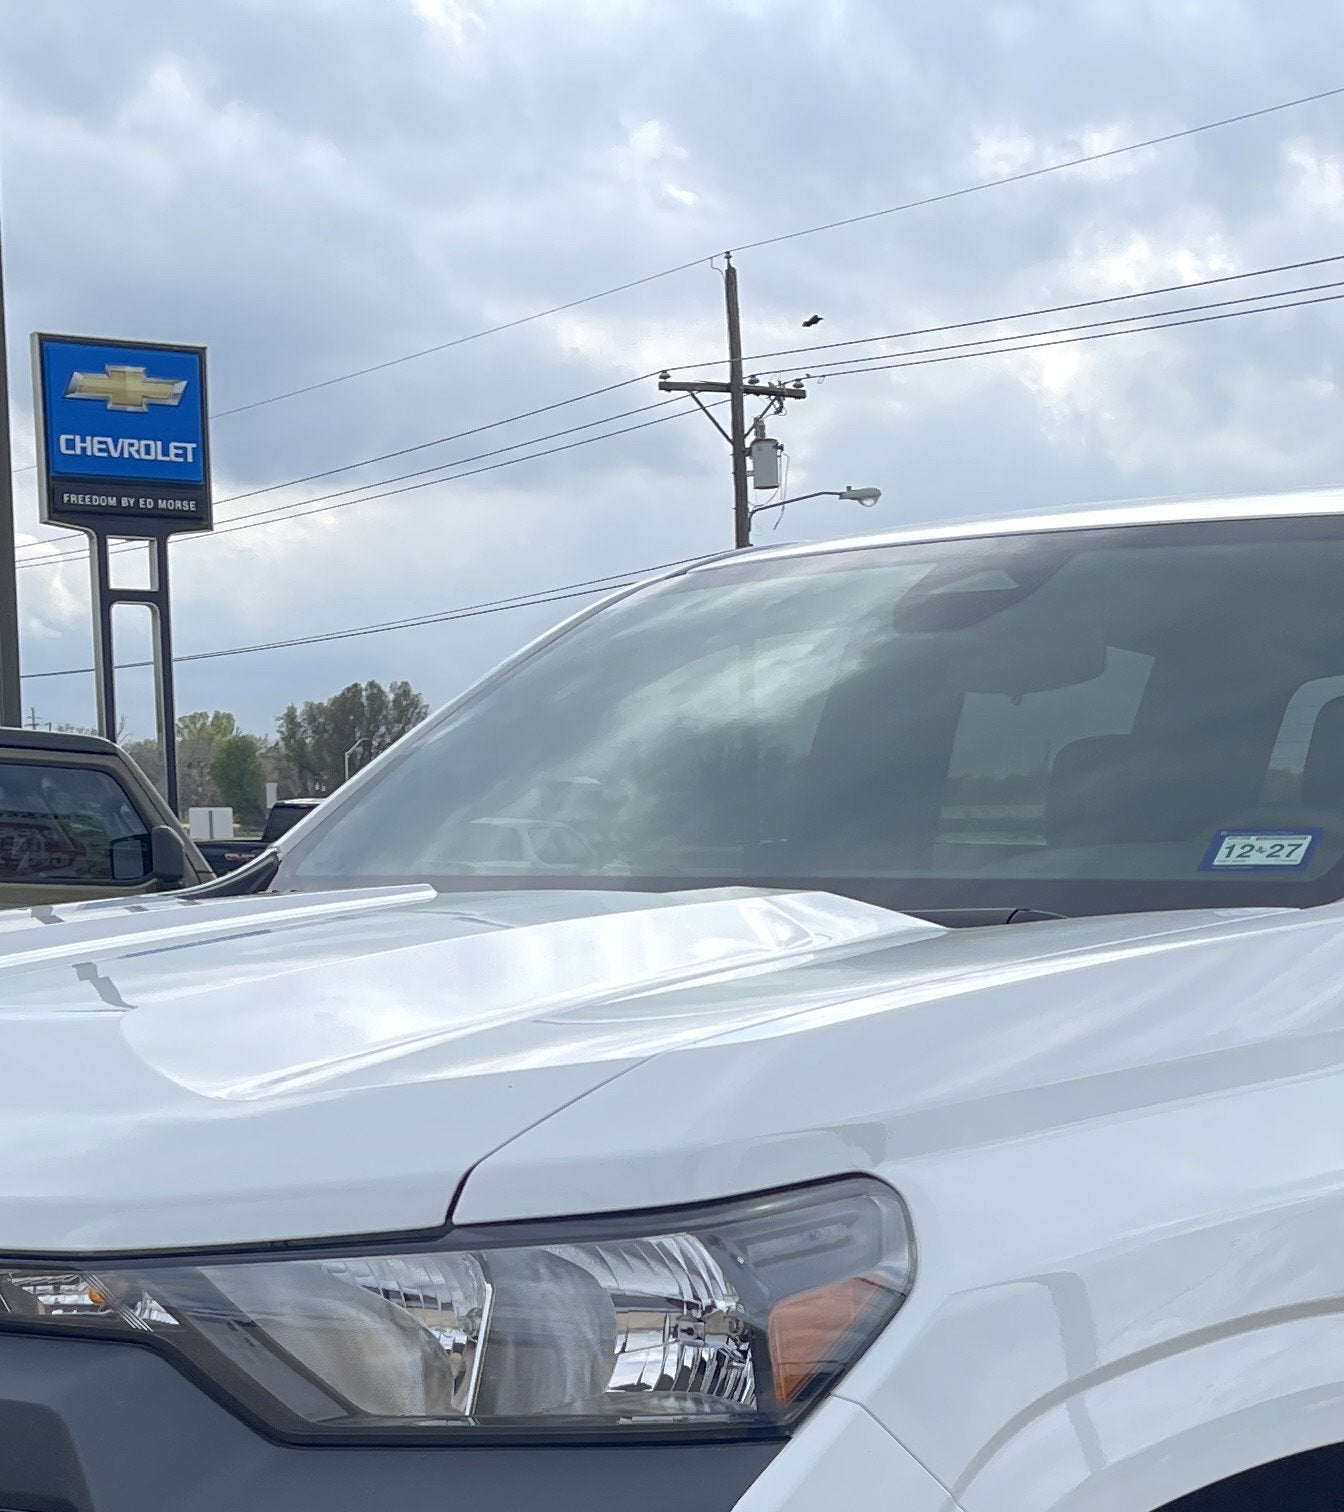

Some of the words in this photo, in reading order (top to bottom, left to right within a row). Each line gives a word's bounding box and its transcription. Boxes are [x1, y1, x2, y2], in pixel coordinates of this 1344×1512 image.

[59, 434, 197, 463] CHEVROLET
[63, 493, 117, 507] FREEDOM
[121, 497, 135, 508] BY
[139, 498, 154, 509] ED
[158, 499, 197, 511] MORSE
